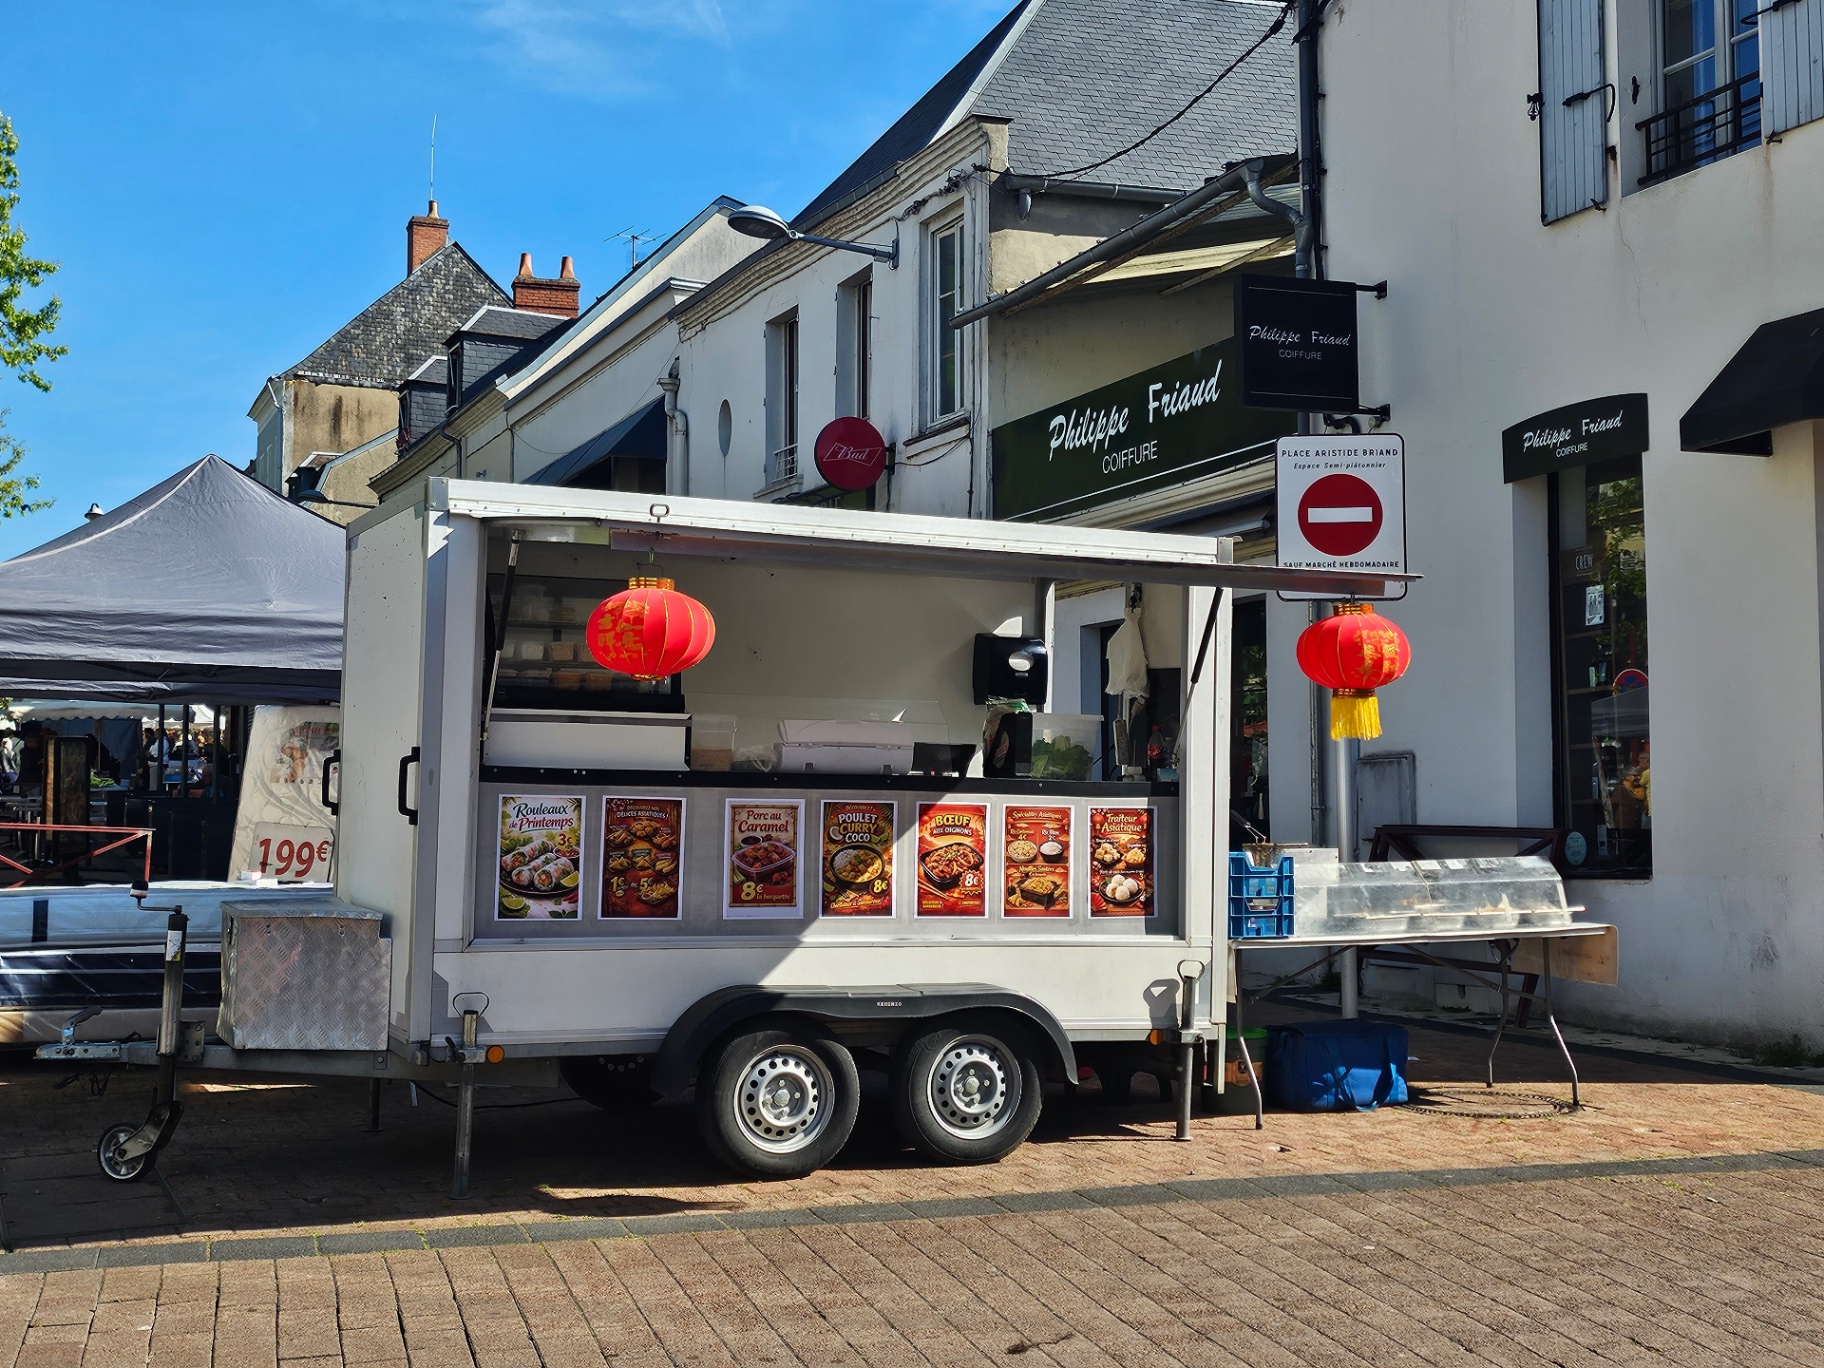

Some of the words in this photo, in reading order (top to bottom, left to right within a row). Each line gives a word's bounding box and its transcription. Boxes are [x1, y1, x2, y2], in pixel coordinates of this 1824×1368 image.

[1248, 324, 1301, 344] Philippe
[1311, 330, 1352, 346] Friaud
[1278, 349, 1323, 361] COIFFURE
[1048, 404, 1130, 461] Philippe
[1147, 359, 1223, 423] Friaud
[1522, 426, 1572, 452] Philippe
[1582, 410, 1624, 436] Friaud
[834, 445, 868, 461] Bud
[1281, 449, 1311, 458] PLACE
[1315, 448, 1359, 457] ARISTIDE
[1362, 448, 1398, 456] BRIAND
[1555, 442, 1588, 458] COIFFURE
[1101, 440, 1158, 474] COIFFURE
[1293, 462, 1320, 470] Espace
[1306, 560, 1337, 568] MARCHÉ
[512, 802, 569, 818] Rouleaux
[746, 810, 769, 820] Porc
[770, 812, 782, 820] au
[508, 820, 518, 829] de
[518, 817, 574, 831] Printemps
[838, 813, 878, 823] POULET
[935, 814, 971, 826] BŒUF
[1106, 813, 1138, 823] Traiteur
[738, 820, 789, 833] Caramel
[839, 823, 878, 834] CURRY
[944, 827, 972, 836] OIGNONS
[1101, 822, 1142, 834] Asiatique
[558, 833, 573, 846] 3€
[845, 832, 870, 843] COCO
[259, 837, 330, 878] 199€
[873, 880, 888, 893] 8€
[964, 873, 979, 887] 8€
[741, 881, 764, 901] 8€
